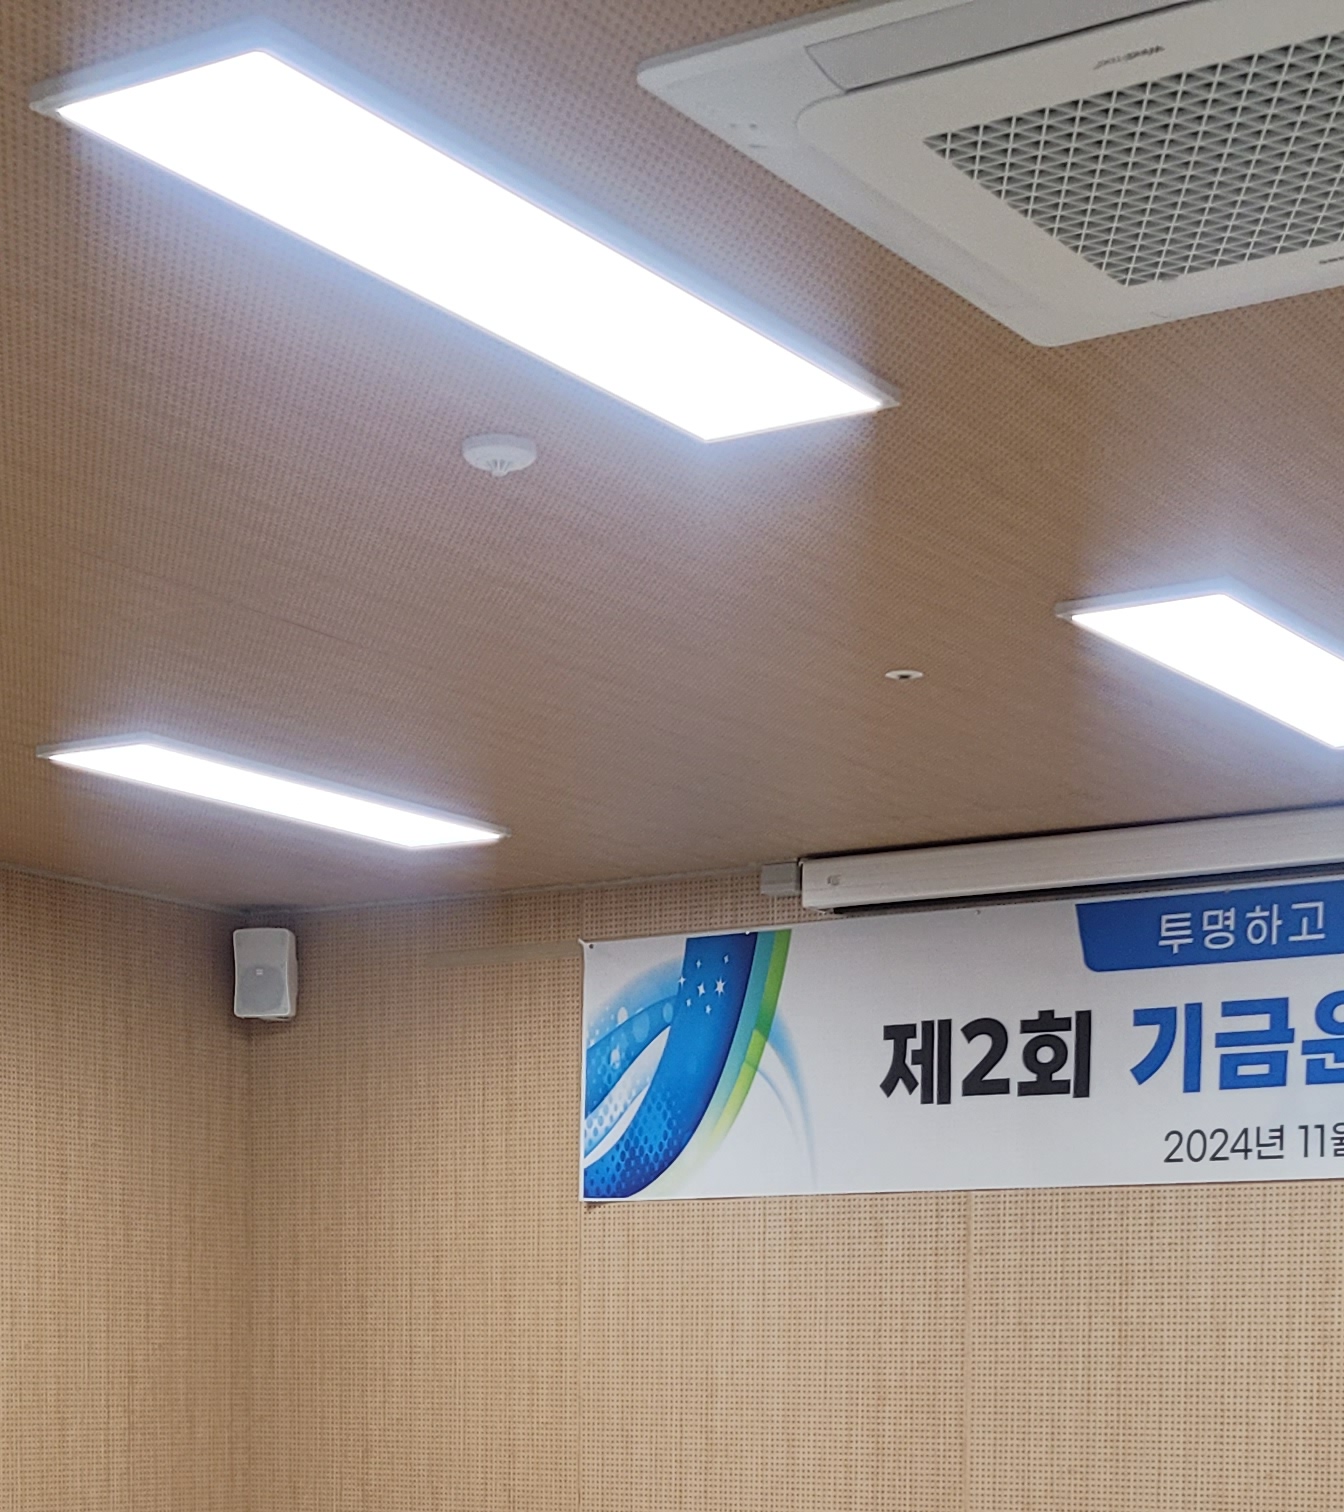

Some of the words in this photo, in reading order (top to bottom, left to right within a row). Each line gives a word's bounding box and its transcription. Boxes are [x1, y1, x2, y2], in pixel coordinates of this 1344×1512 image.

[1158, 901, 1326, 955] 투명하고
[879, 1009, 1092, 1106] 제2회
[1162, 1125, 1285, 1164] 2024년
